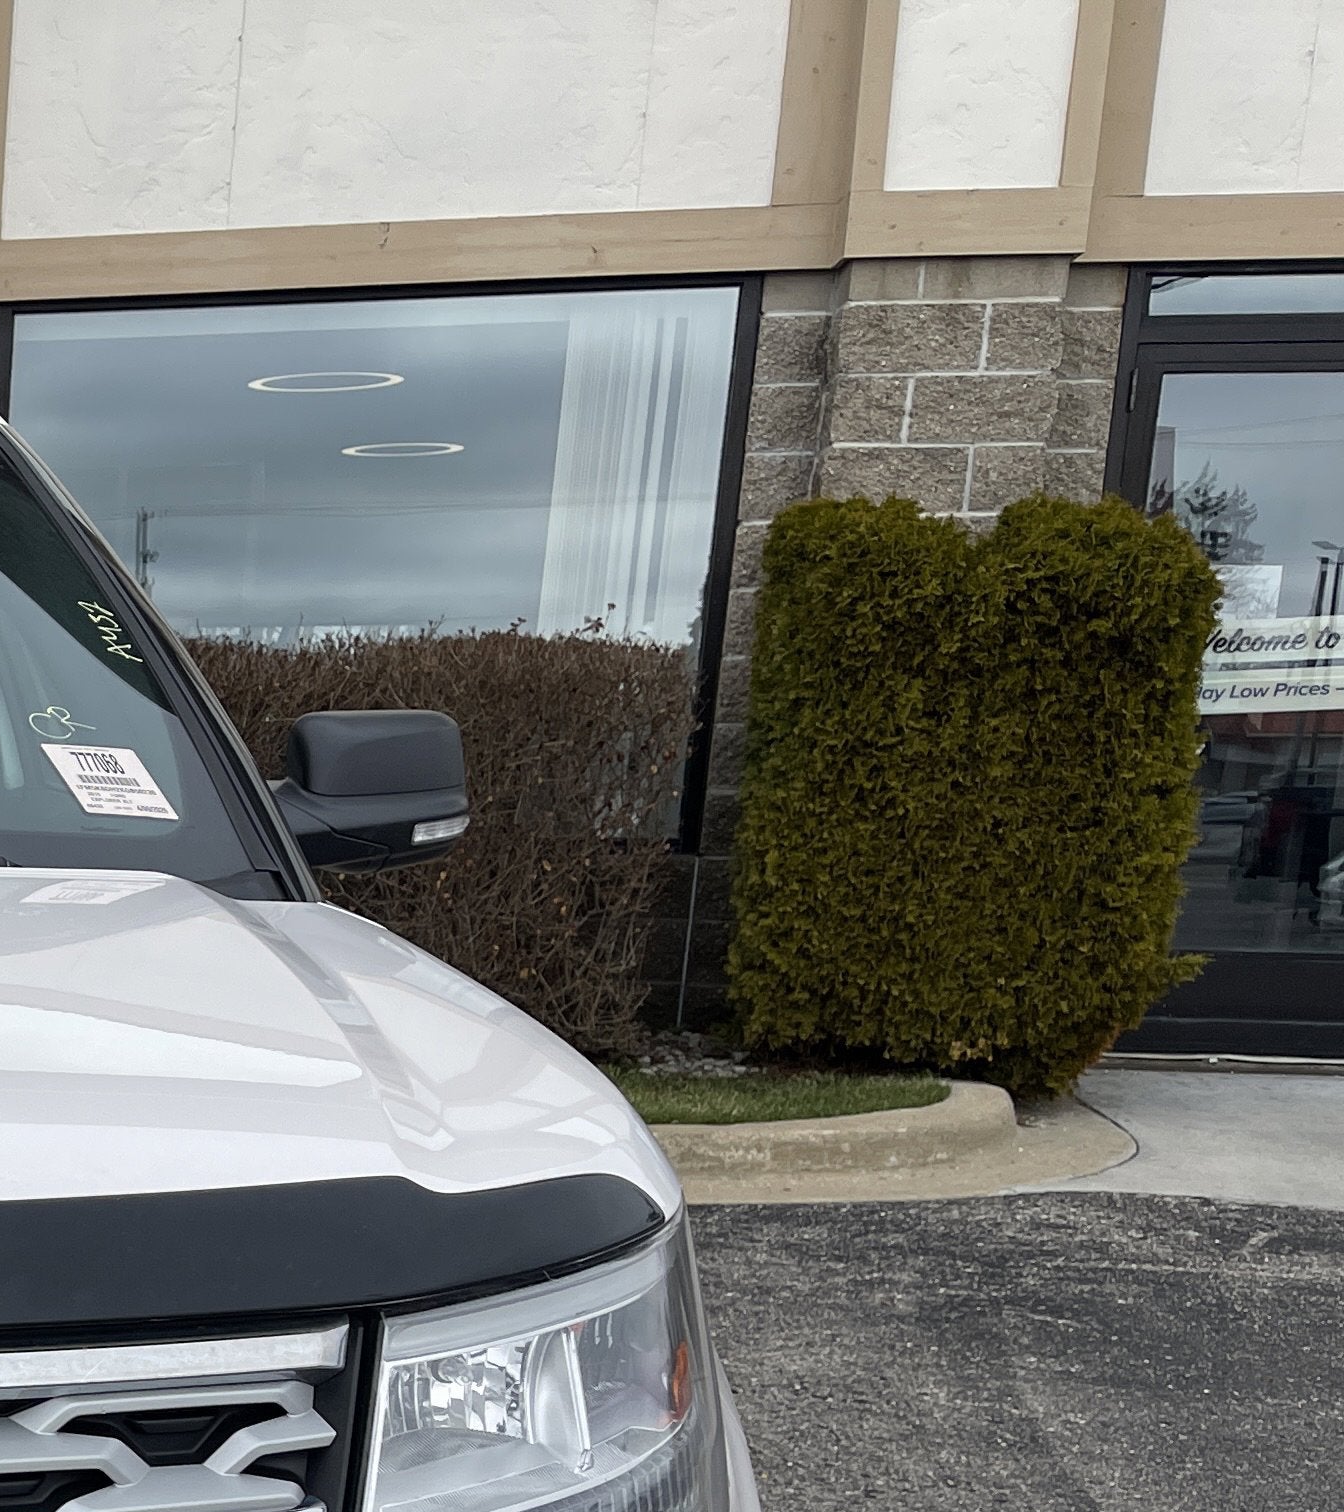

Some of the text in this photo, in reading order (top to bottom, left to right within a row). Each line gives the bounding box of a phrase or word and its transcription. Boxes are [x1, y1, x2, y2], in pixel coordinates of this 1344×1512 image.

[1315, 626, 1341, 650] to
[1229, 685, 1270, 699] Low
[1273, 682, 1330, 697] Prices
[69, 752, 126, 774] 777068
